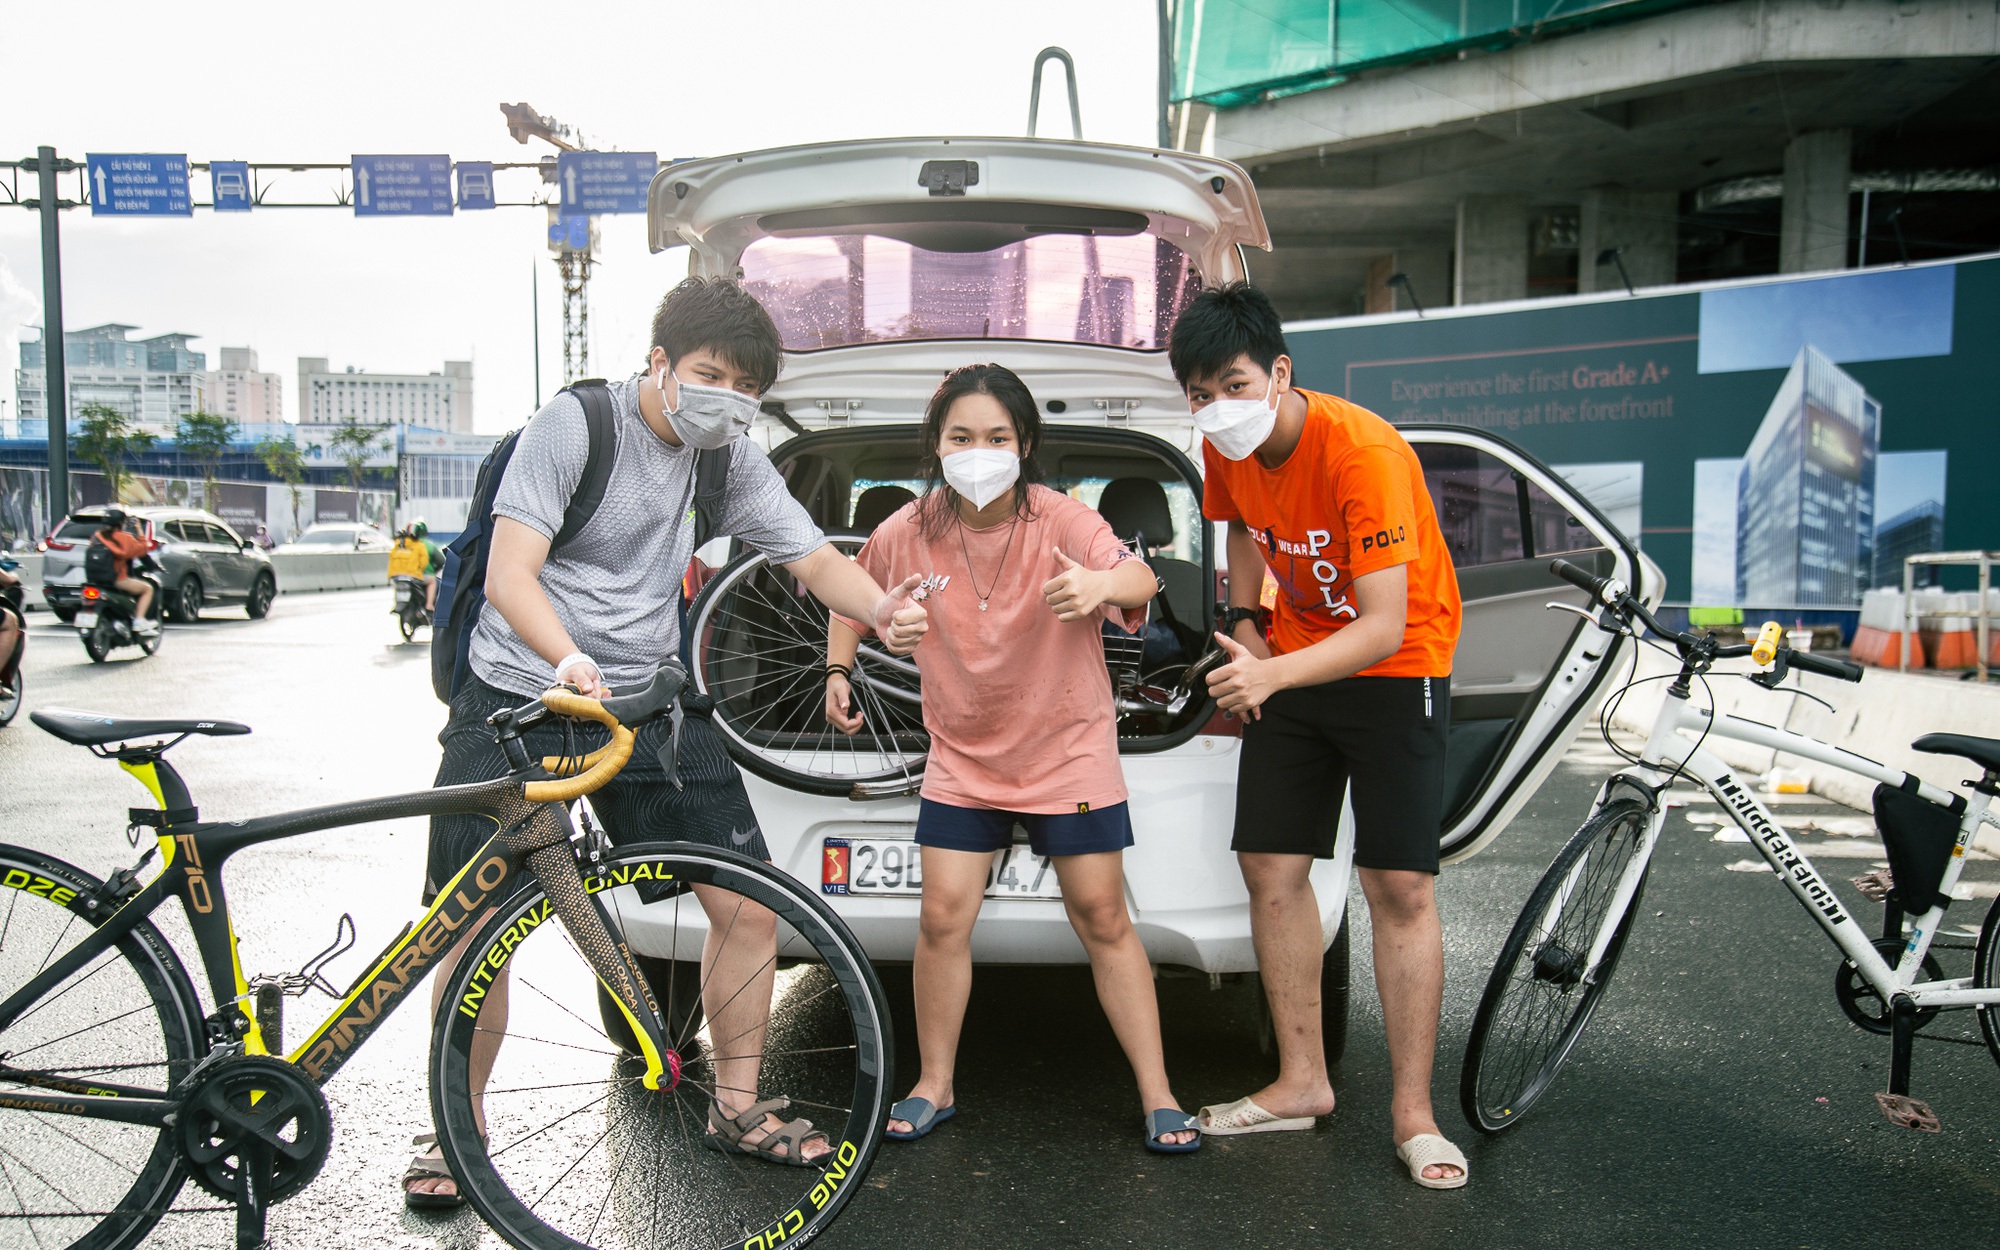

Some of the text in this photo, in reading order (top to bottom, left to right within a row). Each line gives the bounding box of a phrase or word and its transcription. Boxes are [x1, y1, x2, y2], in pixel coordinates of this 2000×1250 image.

[1391, 361, 1670, 403] Experience the first Grade A+
[1442, 404, 1521, 431] building
[1522, 404, 1541, 425] at
[1545, 401, 1576, 424] the
[1579, 395, 1675, 422] forefront
[1278, 539, 1308, 556] WEAR
[1363, 525, 1405, 553] POLO
[824, 885, 846, 893] VIE
[301, 856, 508, 1080] PINARELLO
[616, 964, 639, 1010] ONDA
[617, 941, 659, 1012] PINARELLO
[809, 1140, 858, 1211] ONG
